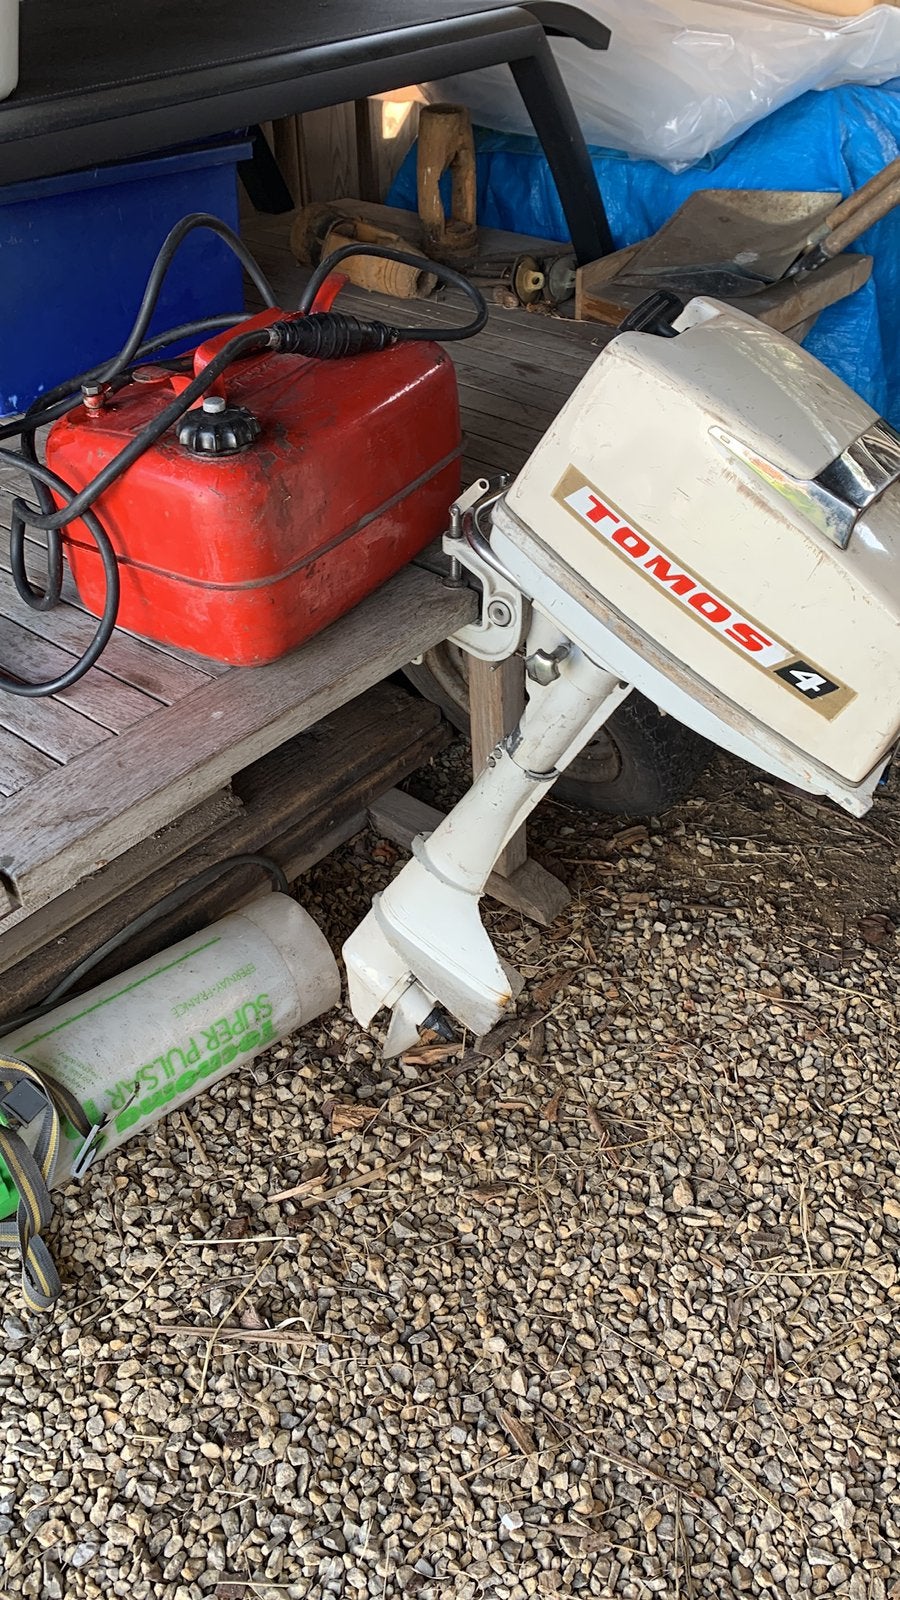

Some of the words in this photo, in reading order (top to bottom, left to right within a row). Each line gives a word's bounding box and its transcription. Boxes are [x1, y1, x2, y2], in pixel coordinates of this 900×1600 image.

[586, 495, 773, 652] TOMOS
[788, 669, 827, 692] 4
[200, 993, 273, 1051] SUPER
[104, 1036, 201, 1110] PULSAR
